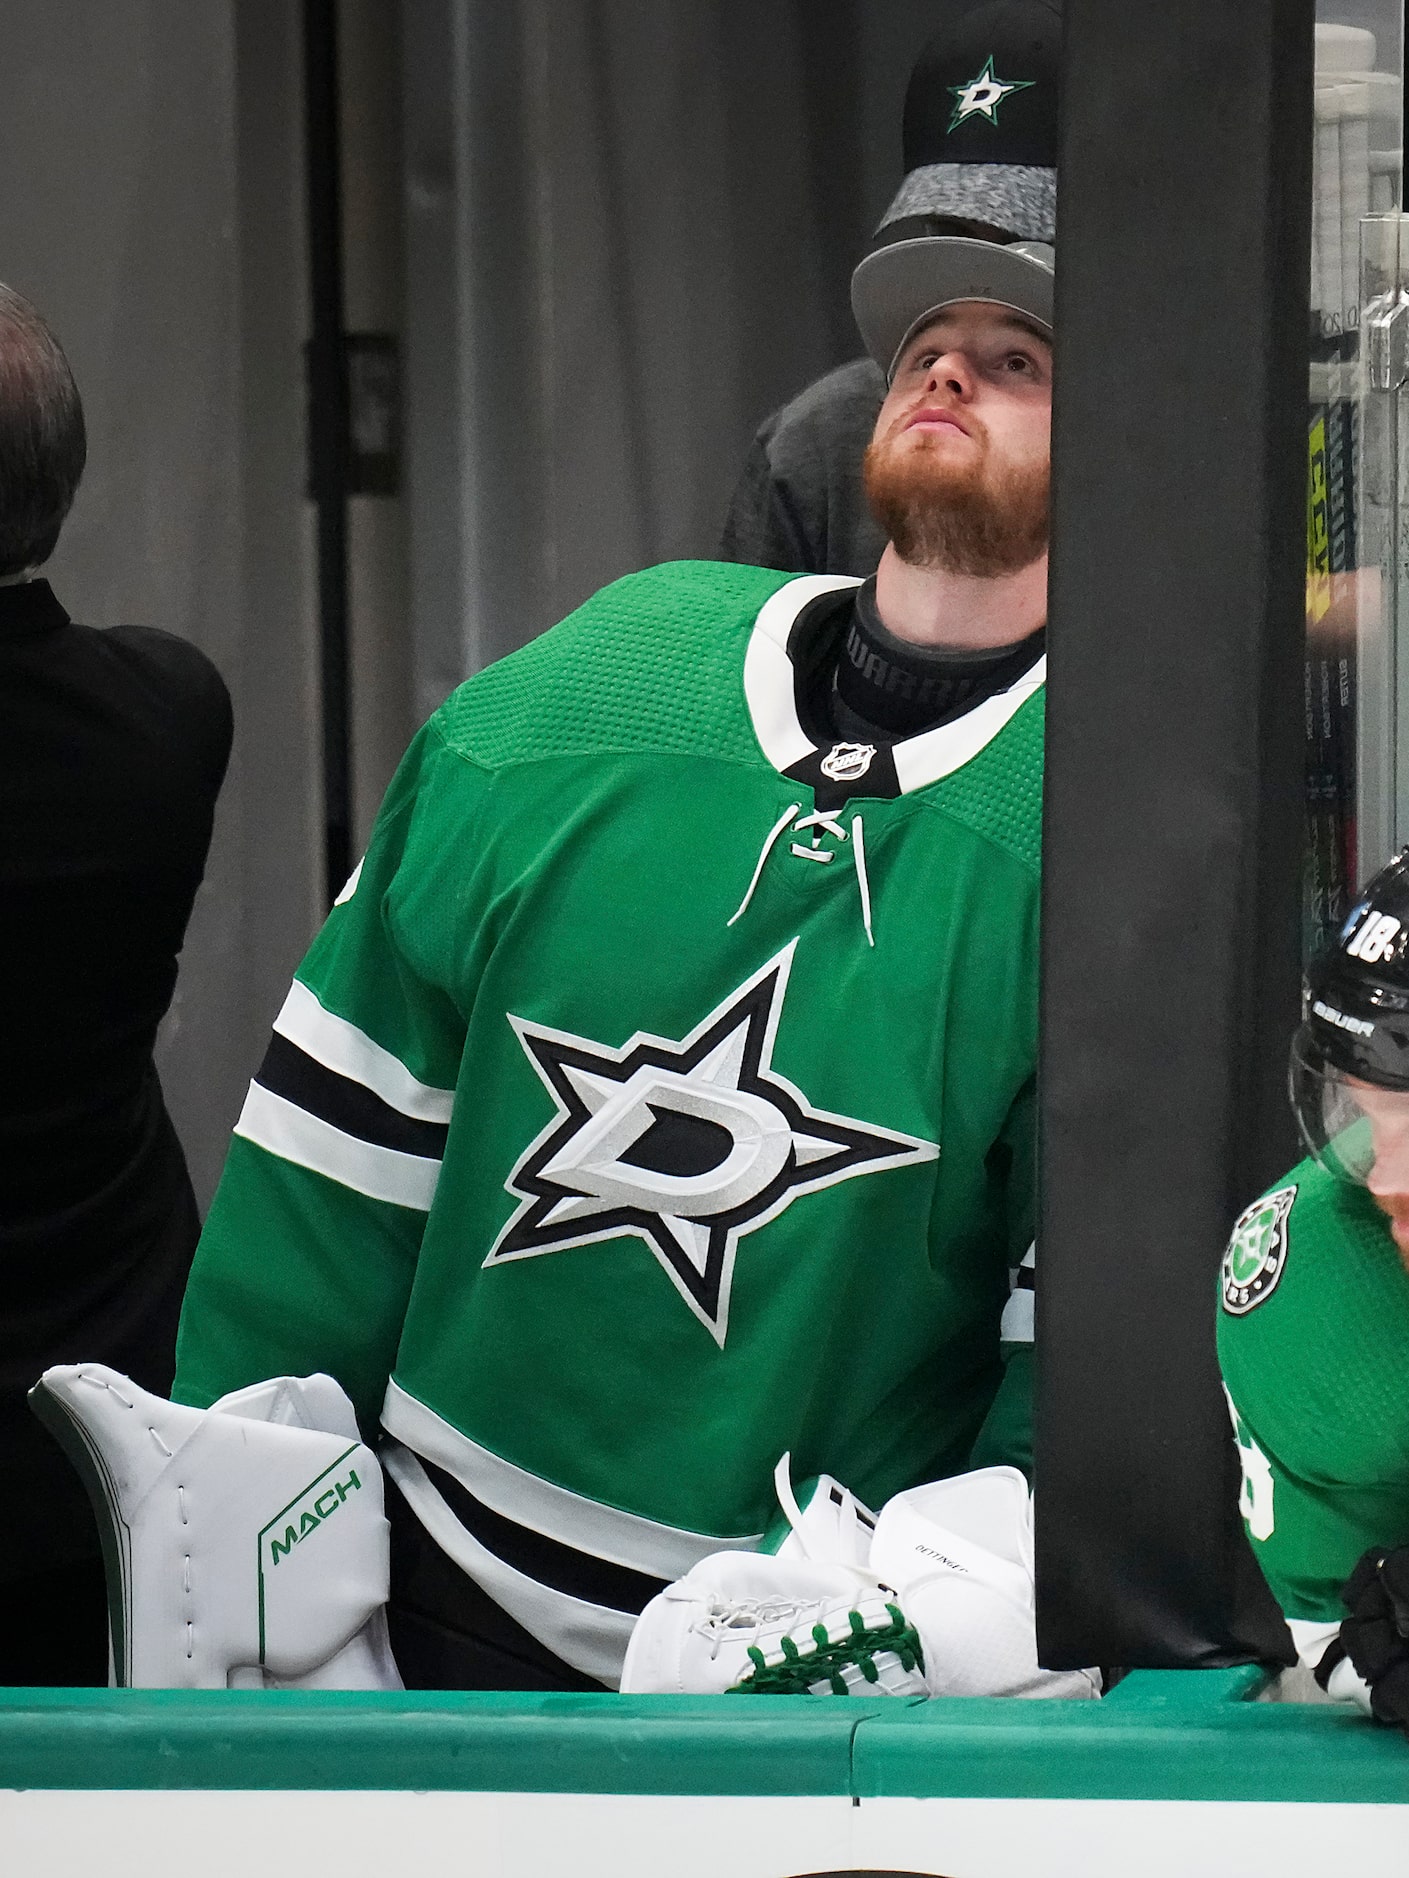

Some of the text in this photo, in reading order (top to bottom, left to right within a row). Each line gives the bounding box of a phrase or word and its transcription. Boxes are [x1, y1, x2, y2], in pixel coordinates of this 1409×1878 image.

[846, 624, 974, 707] WARRI
[1346, 910, 1401, 963] 18
[270, 1469, 362, 1566] MACH
